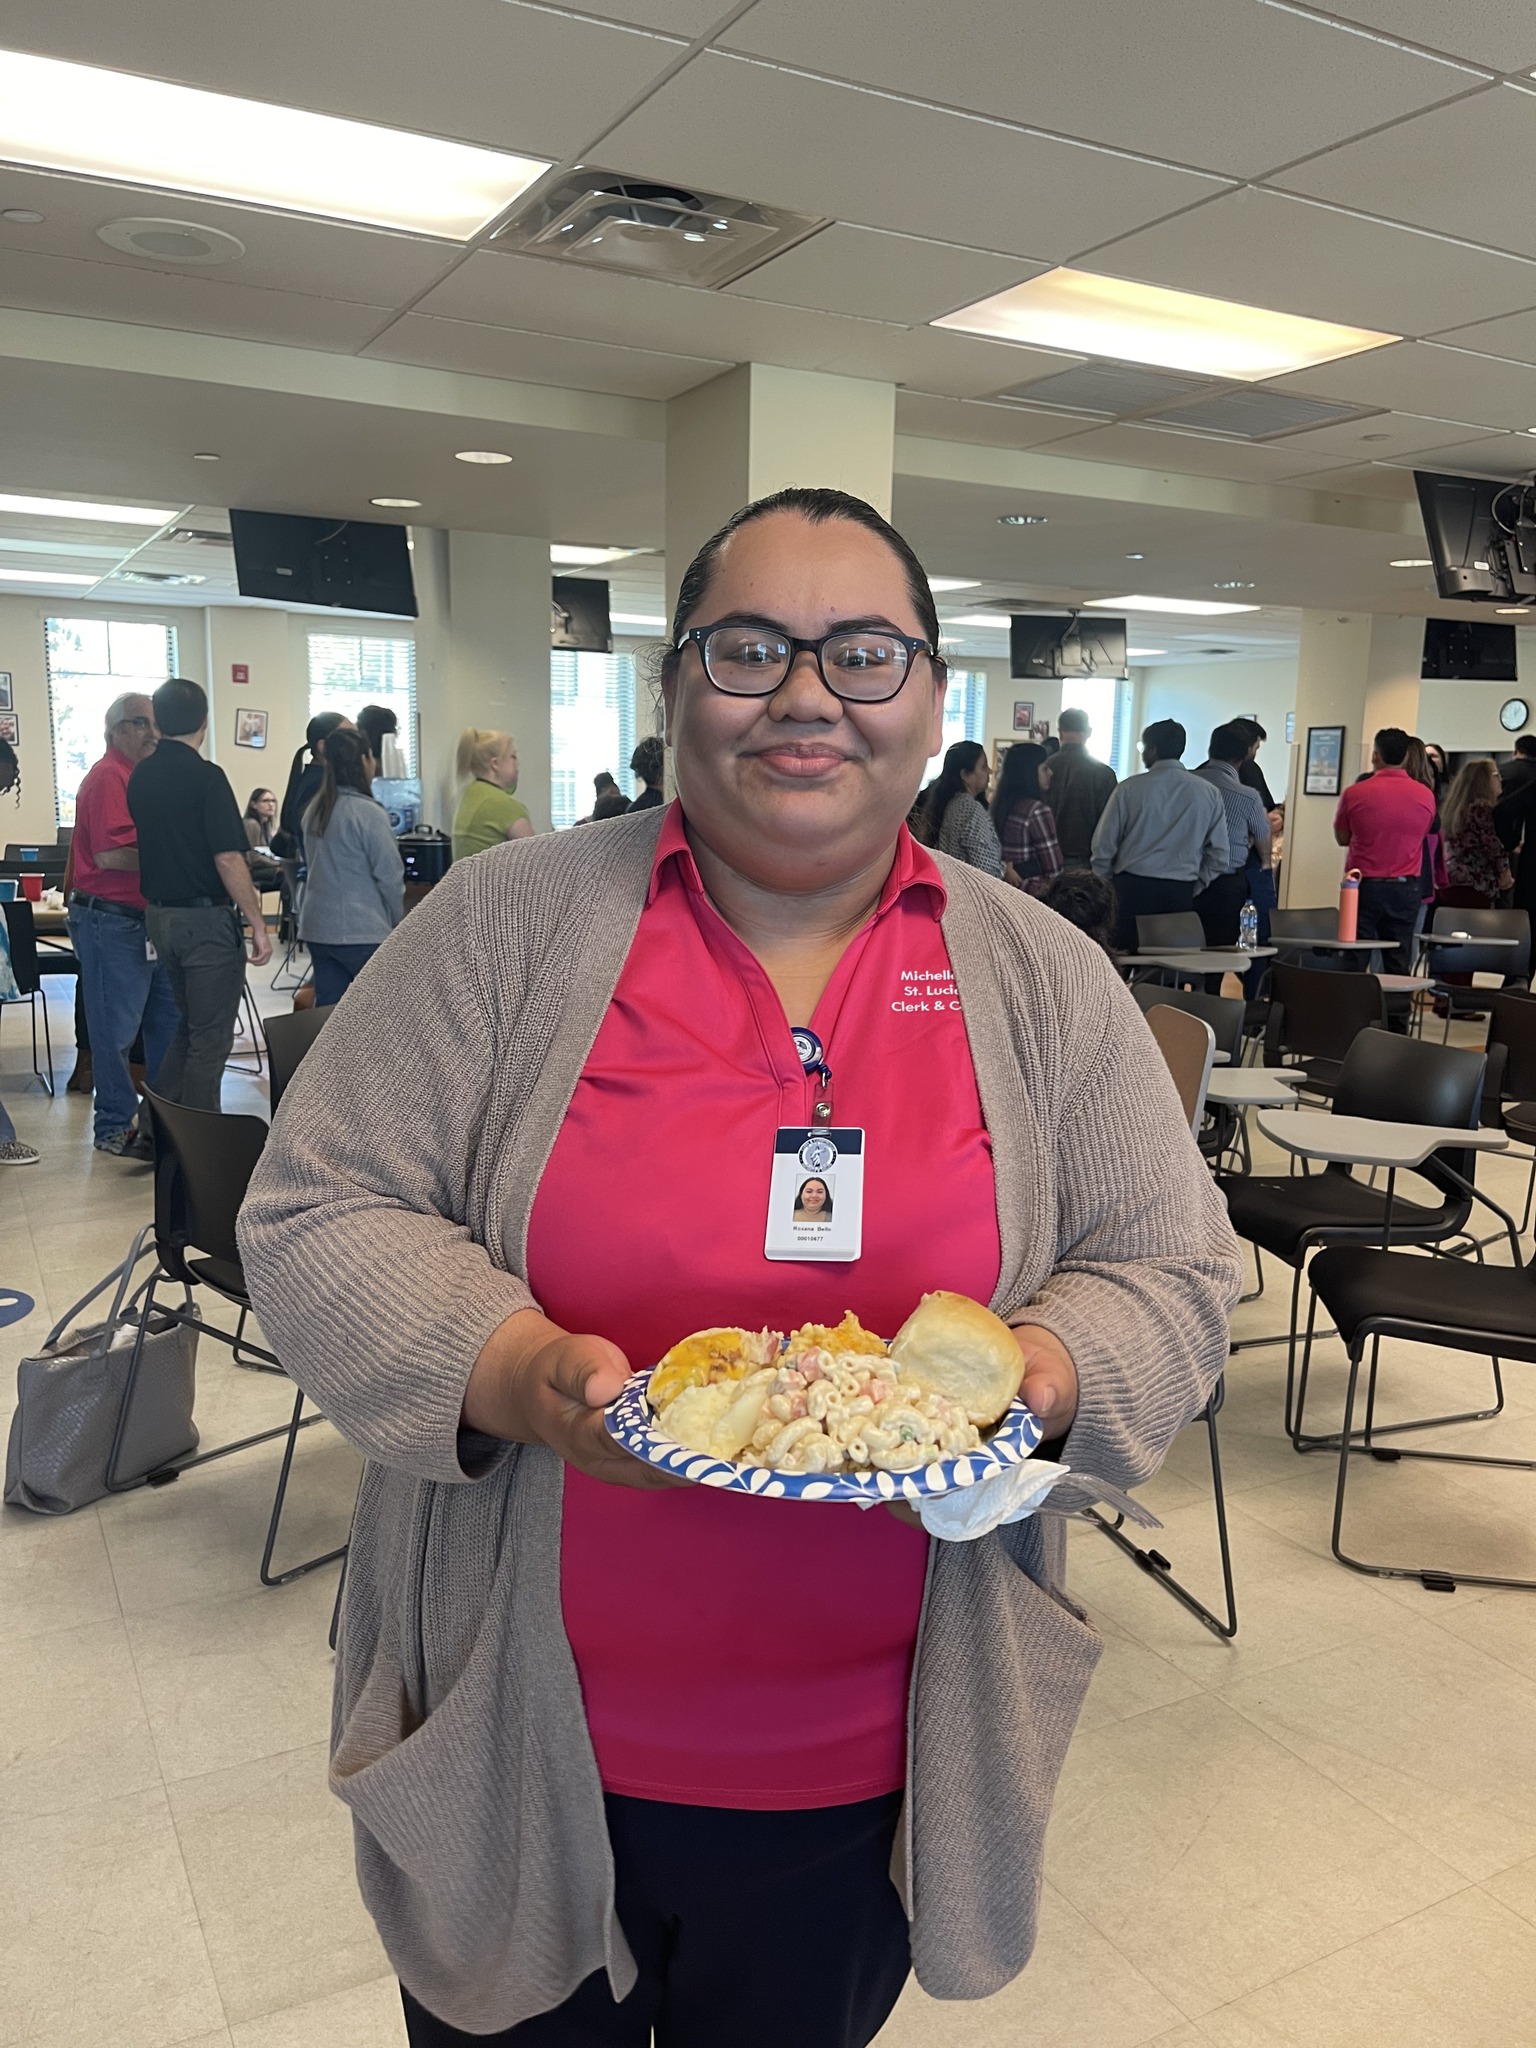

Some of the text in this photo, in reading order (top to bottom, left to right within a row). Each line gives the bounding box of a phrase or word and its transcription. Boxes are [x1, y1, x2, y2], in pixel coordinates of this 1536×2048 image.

[904, 986, 922, 996] St.
[891, 1001, 930, 1012] Clerk
[934, 1001, 945, 1010] &
